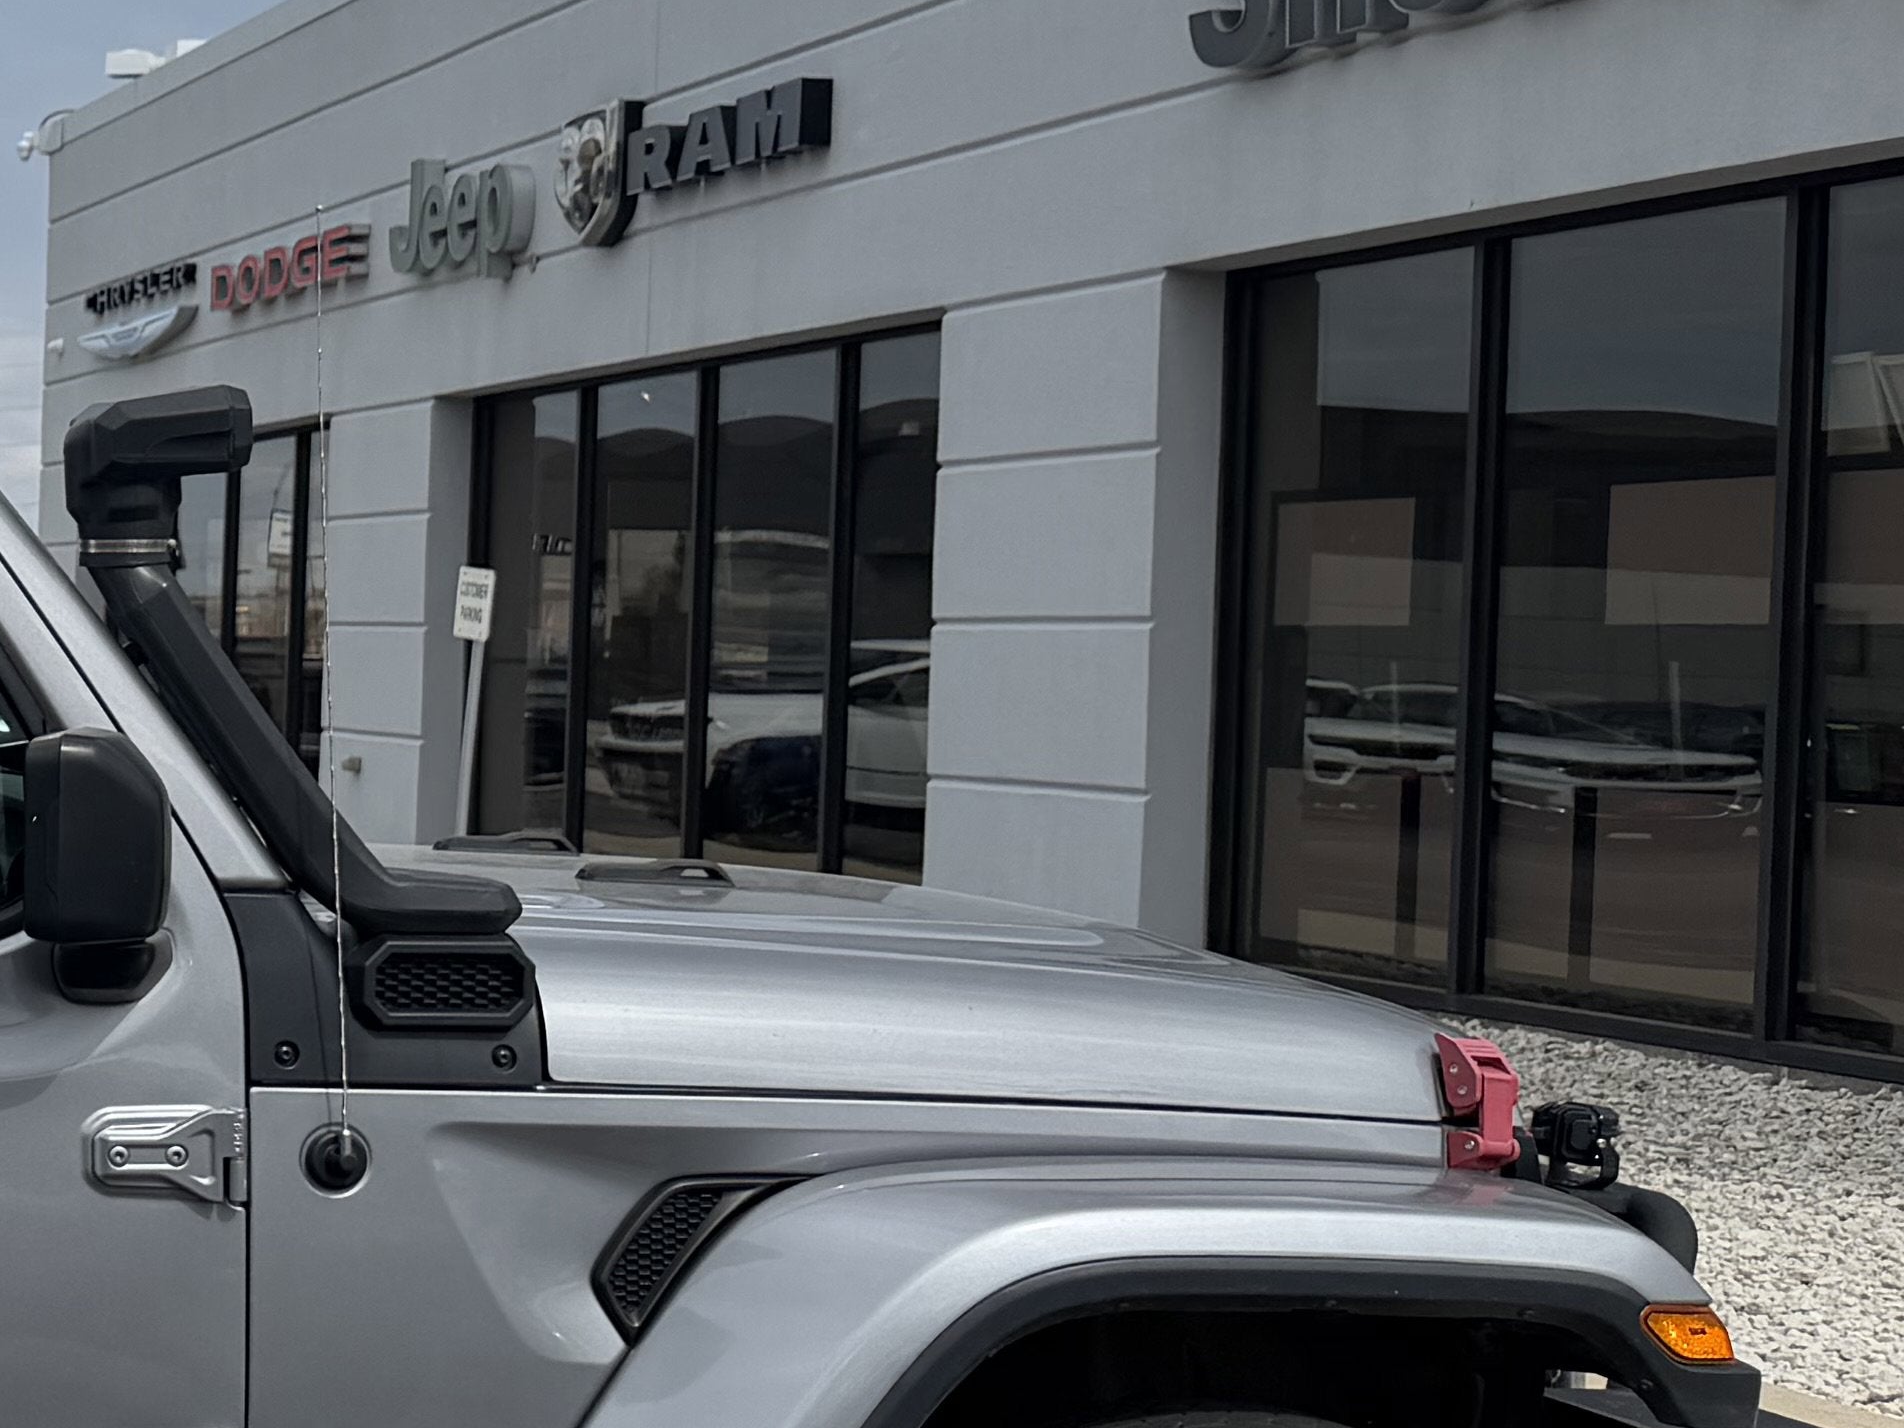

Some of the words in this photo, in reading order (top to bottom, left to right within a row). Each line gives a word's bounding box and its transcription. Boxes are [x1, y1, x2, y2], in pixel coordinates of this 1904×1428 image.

[626, 77, 833, 196] RAM
[210, 224, 371, 312] DODGE
[389, 159, 536, 278] Jeep
